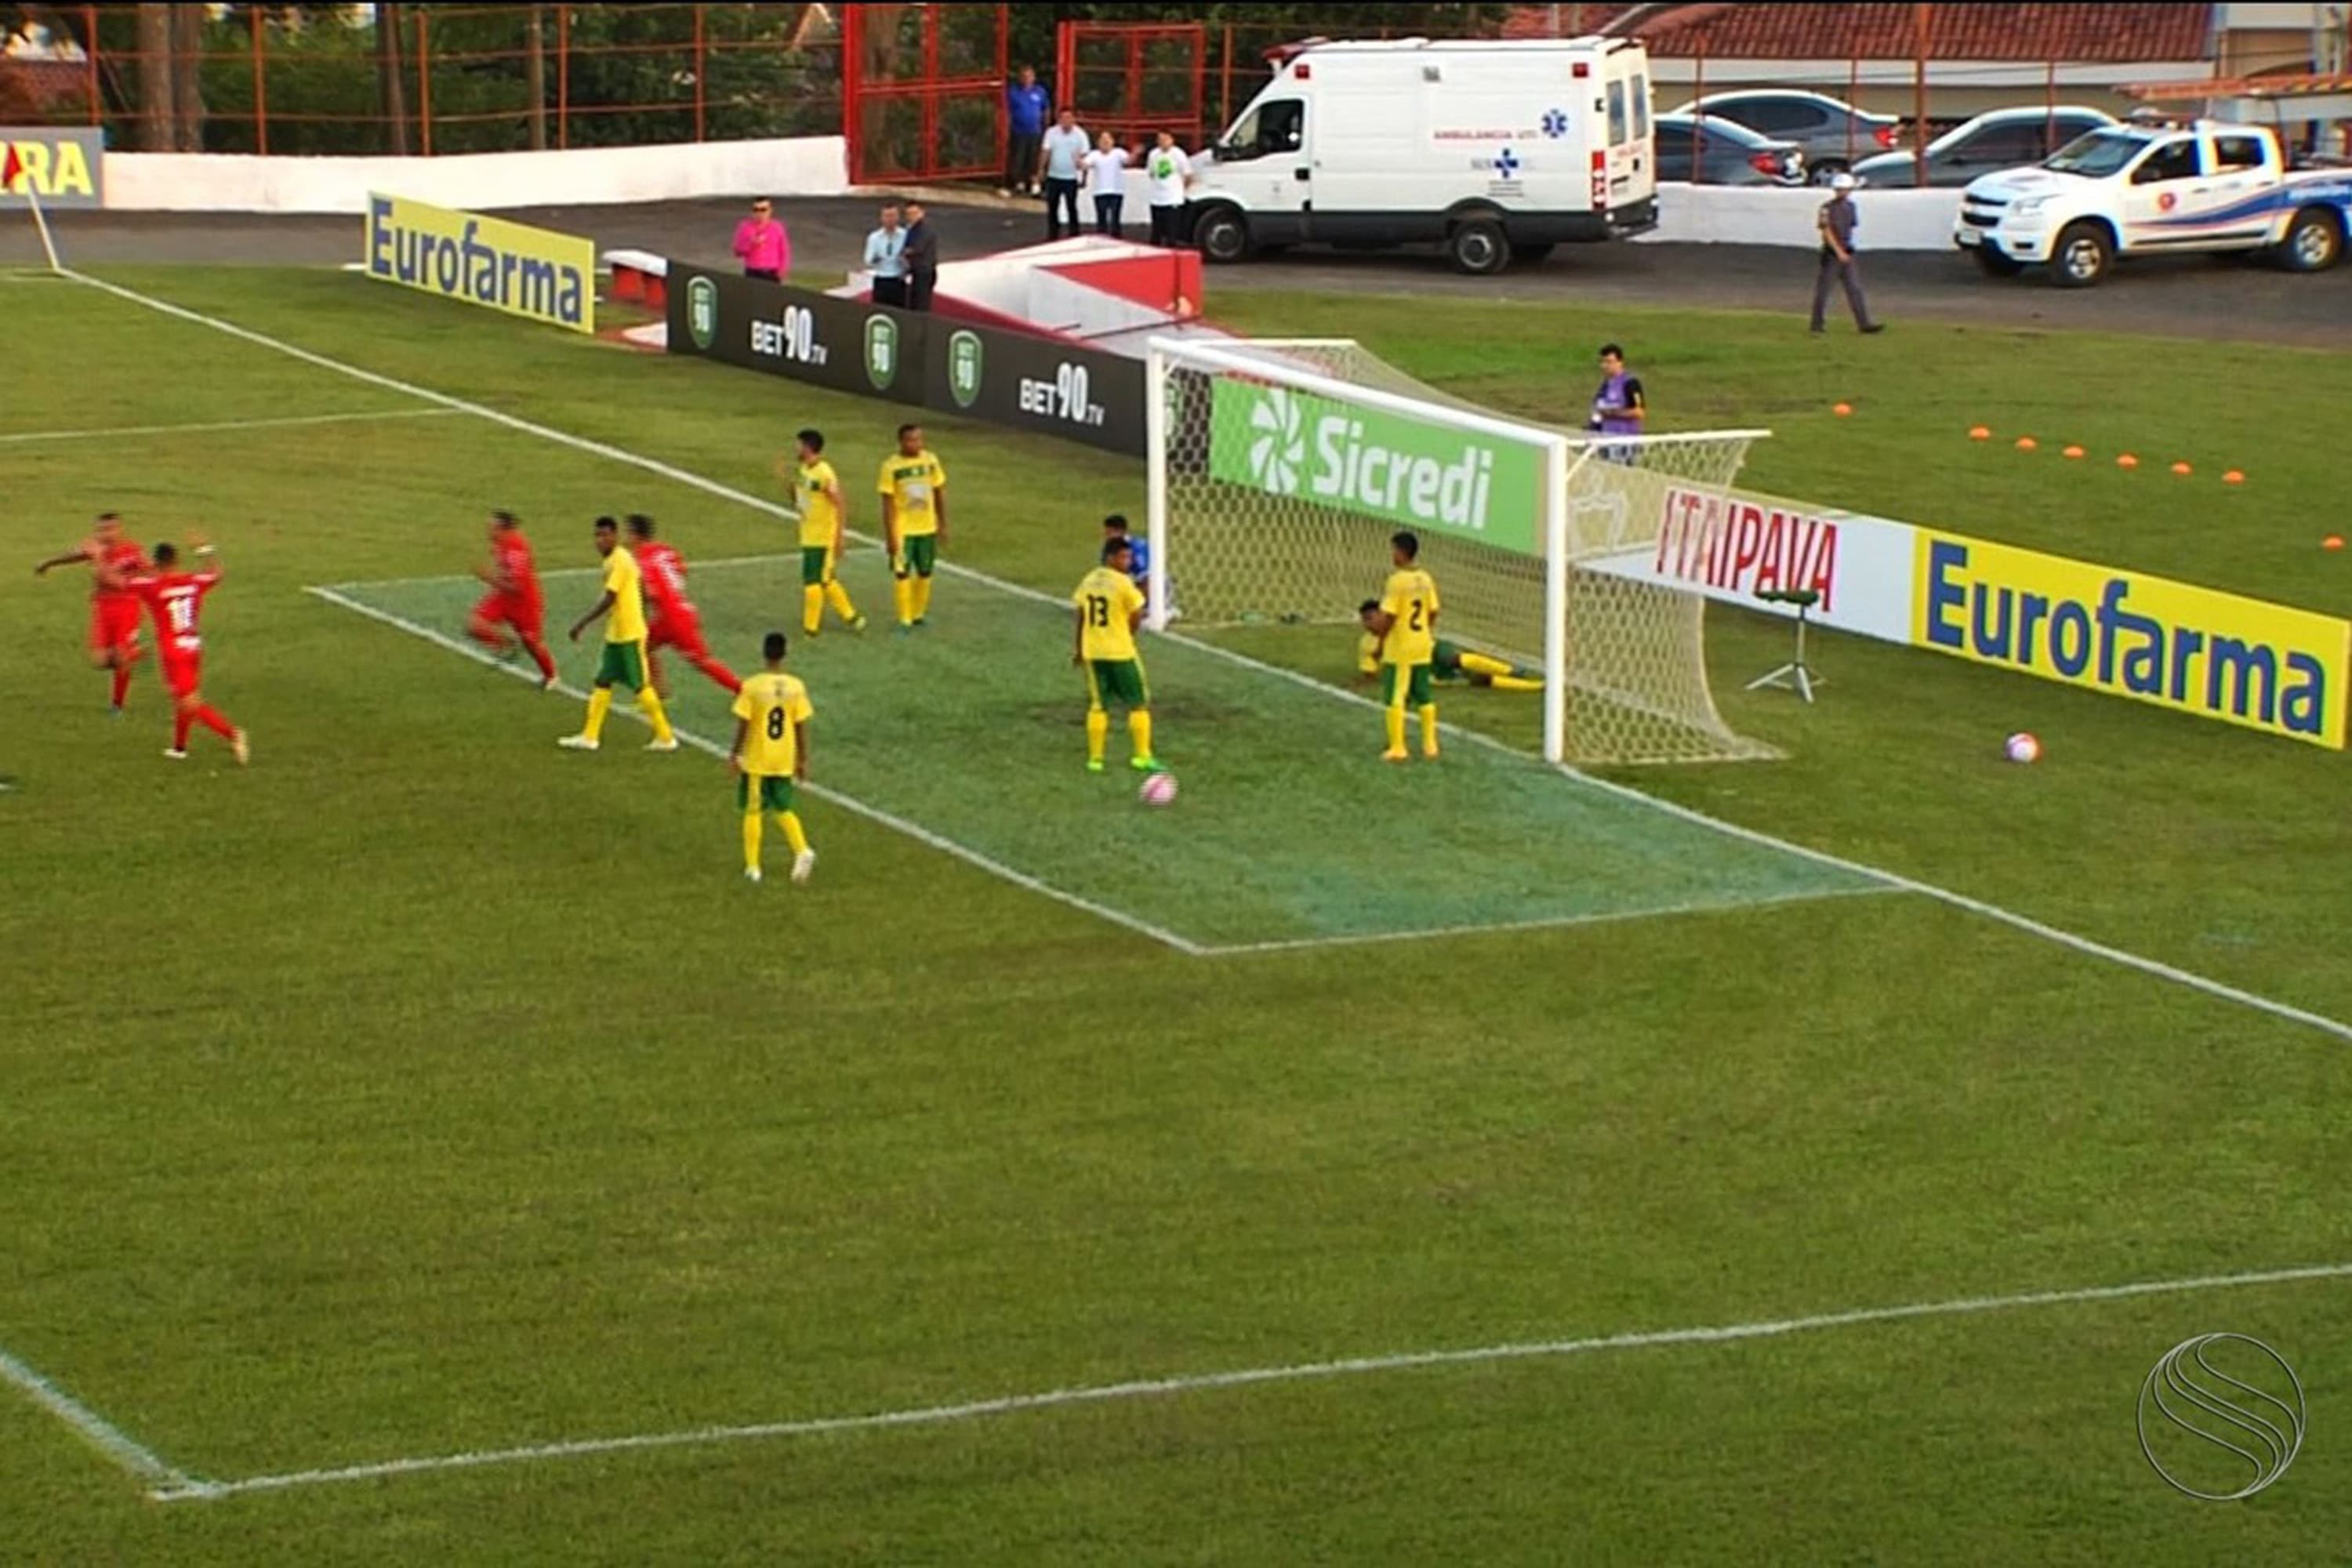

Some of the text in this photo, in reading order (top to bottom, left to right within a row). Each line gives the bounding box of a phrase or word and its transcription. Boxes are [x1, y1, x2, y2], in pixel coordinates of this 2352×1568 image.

[0, 141, 93, 194] RA
[372, 198, 582, 324] Eurofarma
[1312, 416, 1493, 530] Sicredi
[1657, 490, 1837, 612] ITAIPAVA
[1087, 593, 1109, 627] 13
[1410, 599, 1423, 632] 2
[1926, 539, 2324, 735] Eurofarma
[768, 706, 786, 741] 8
